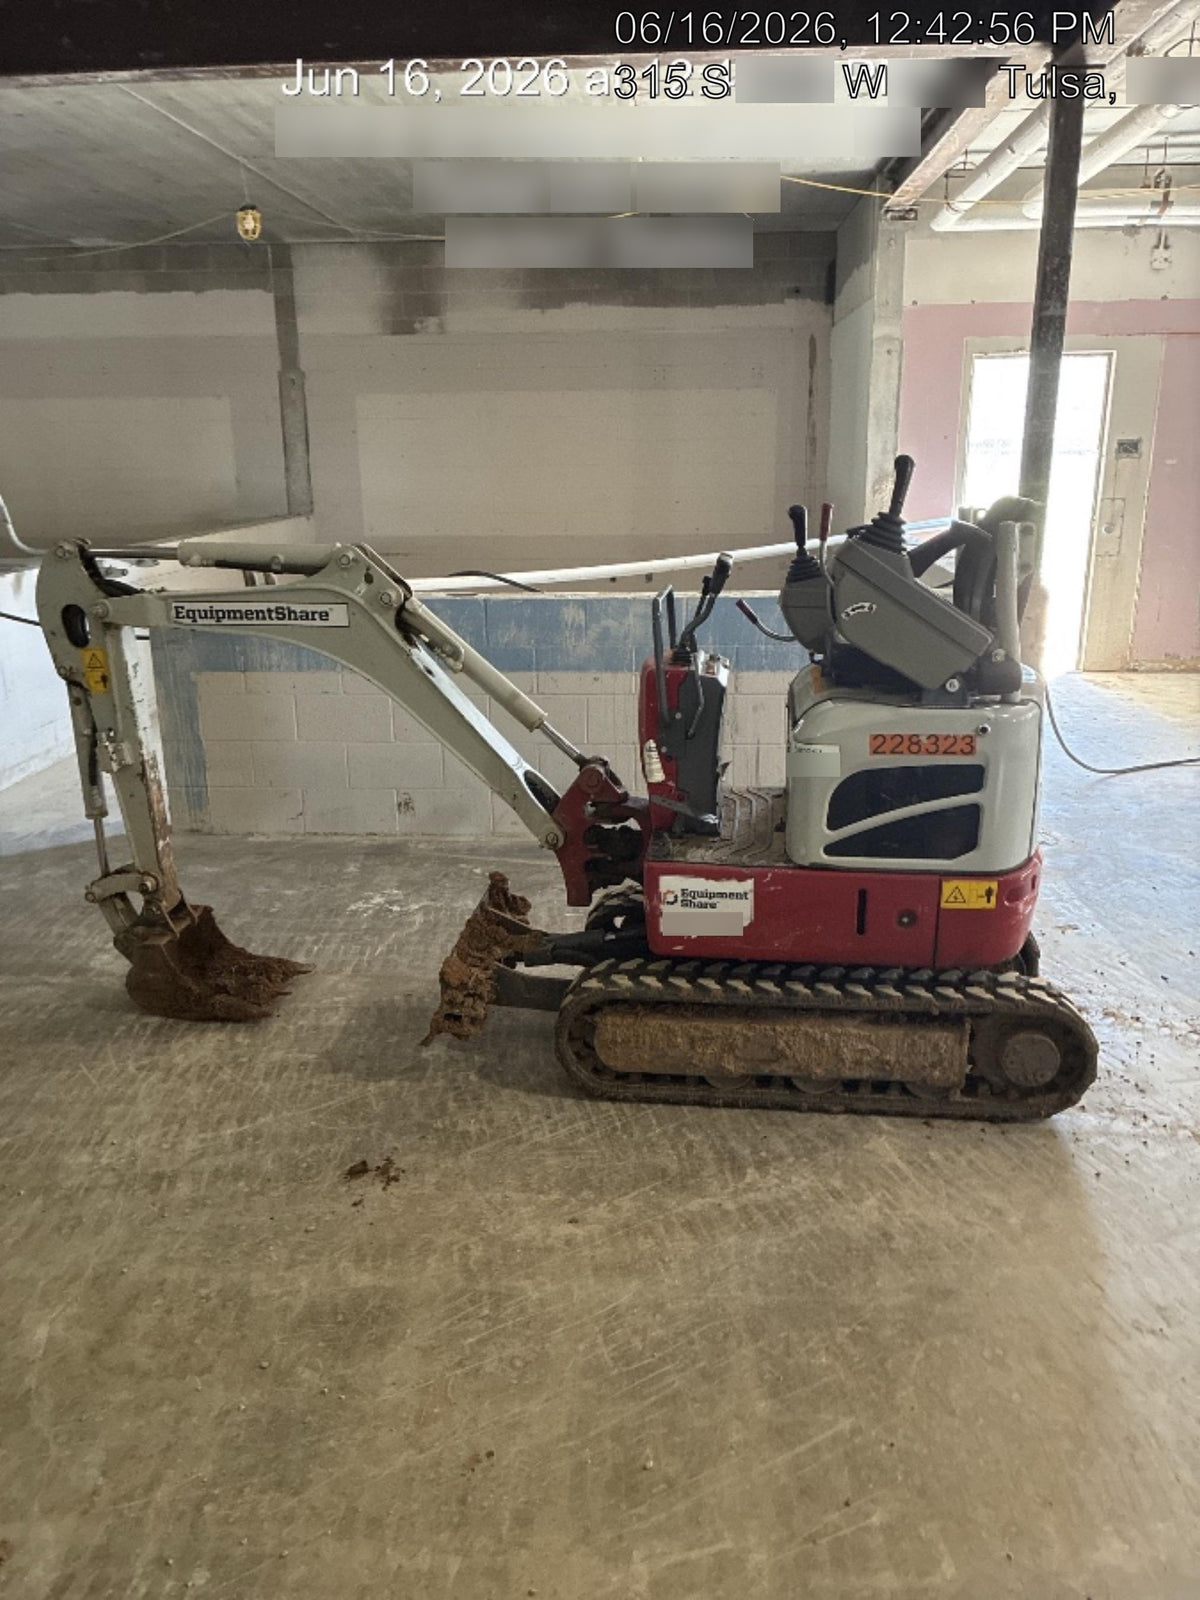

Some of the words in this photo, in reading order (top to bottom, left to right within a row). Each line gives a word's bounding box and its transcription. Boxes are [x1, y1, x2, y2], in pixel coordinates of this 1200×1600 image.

[174, 605, 331, 623] EquipmentShare
[872, 734, 976, 755] 228323
[680, 888, 749, 900] Equipment
[680, 899, 717, 909] Share
